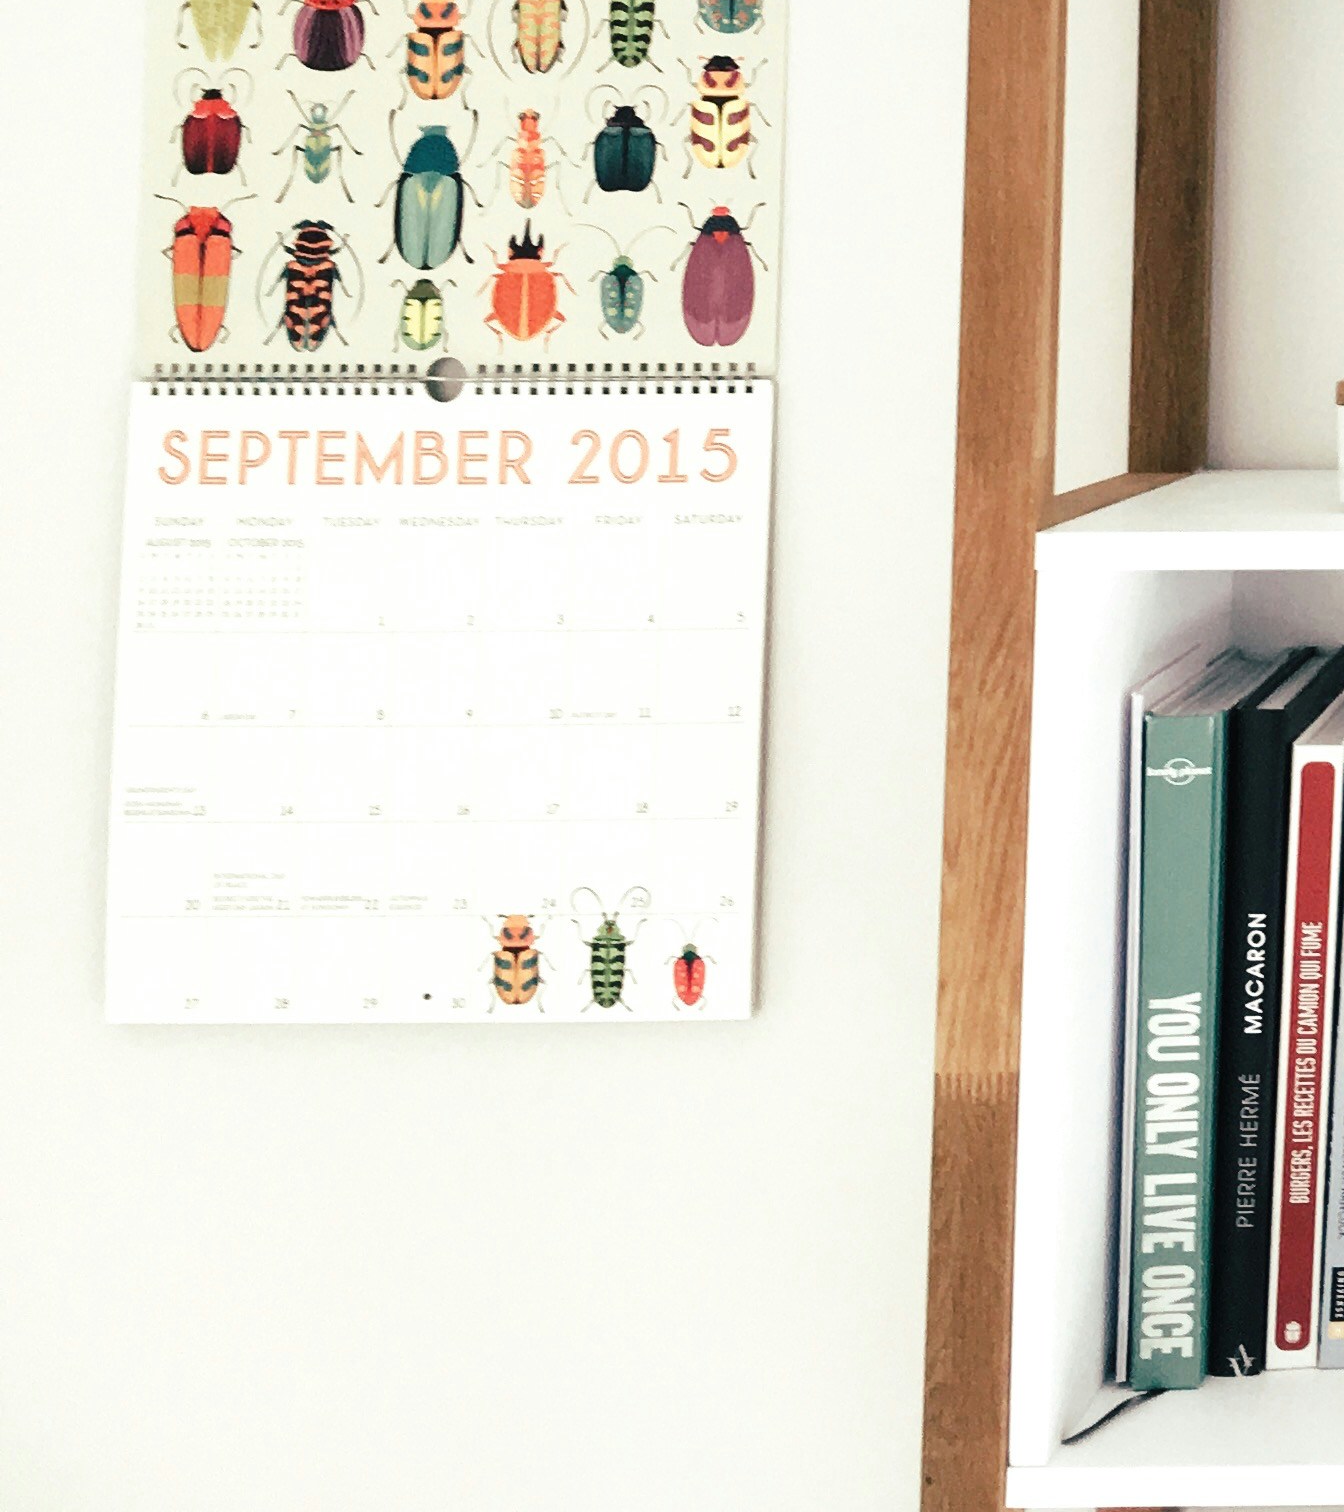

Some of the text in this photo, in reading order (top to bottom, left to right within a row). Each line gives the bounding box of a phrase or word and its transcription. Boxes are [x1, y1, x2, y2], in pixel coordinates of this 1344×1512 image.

[157, 427, 739, 487] SEPTEMBER 2015
[236, 516, 294, 527] MONDAY
[323, 516, 381, 527] TUESDAY
[399, 515, 480, 526] WEDNESDAY
[495, 515, 563, 526] THURSDAY
[595, 514, 642, 525] FRIDAY
[673, 513, 743, 525] SATURDAY
[1243, 913, 1267, 1034] MACARON
[1289, 922, 1322, 1204] BURGERS, LES RECETTES DU CAMION QUI FUME
[1139, 992, 1201, 1360] YOU ONLY LIVE ONCE
[1236, 1074, 1260, 1228] PIERRE HERMÉ
